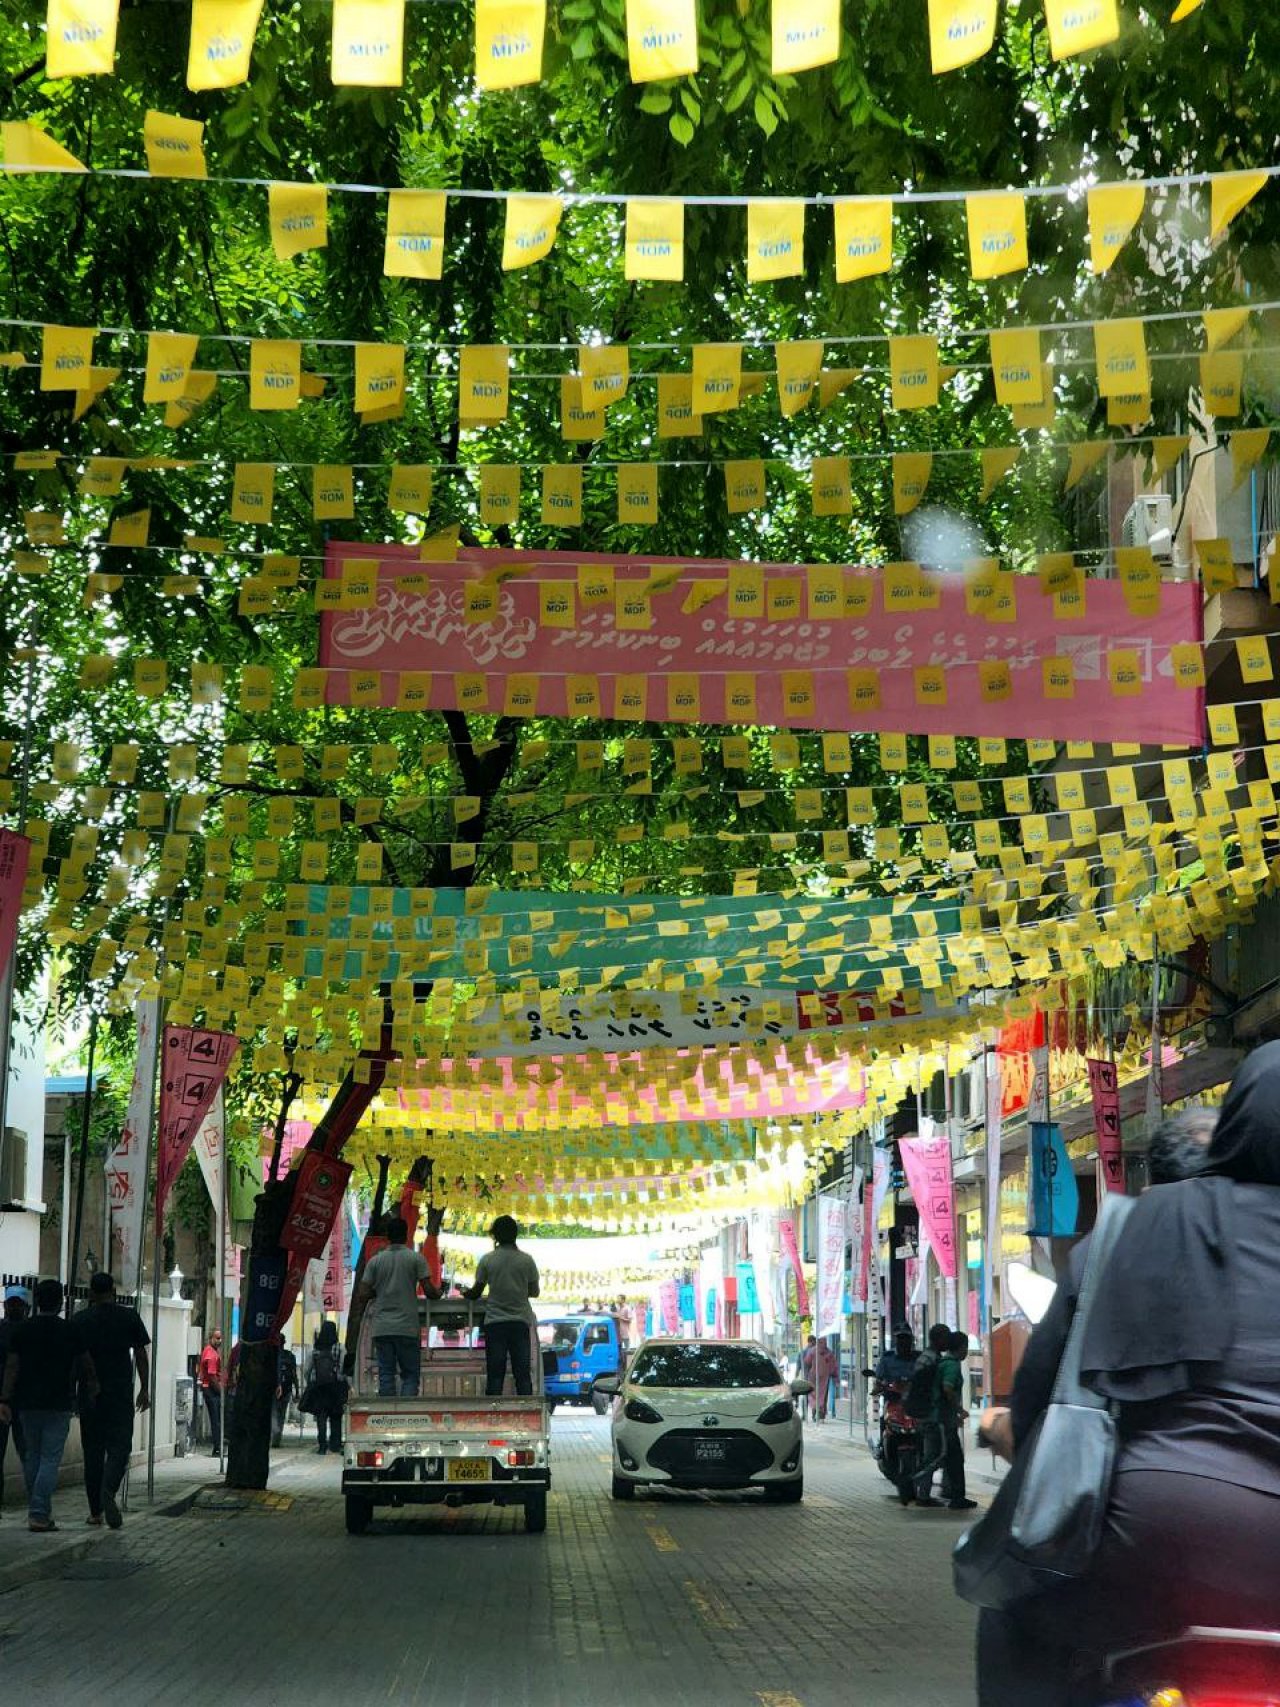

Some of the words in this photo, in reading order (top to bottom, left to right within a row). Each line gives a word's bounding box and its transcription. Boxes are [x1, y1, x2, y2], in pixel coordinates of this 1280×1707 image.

[64, 28, 102, 42] MDP
[643, 33, 681, 49] MDP
[206, 42, 241, 59] MDP
[348, 44, 388, 56] MDP
[490, 41, 528, 57] MDP
[848, 242, 881, 256] MDP
[982, 236, 1014, 252] MDP
[56, 358, 84, 369] MDP
[159, 371, 184, 383] MDP
[264, 377, 293, 387] MDP
[368, 380, 396, 392] MDP
[594, 378, 620, 390] MDP
[705, 383, 733, 393] MDP
[473, 385, 501, 397] MDP
[736, 594, 756, 602] MDP
[774, 600, 794, 608] MDP
[815, 595, 836, 603] MDP
[847, 597, 865, 605] MDP
[471, 602, 491, 611] MDP
[546, 604, 567, 613] MDP
[624, 606, 645, 615] MDP
[291, 1214, 326, 1234] 2023
